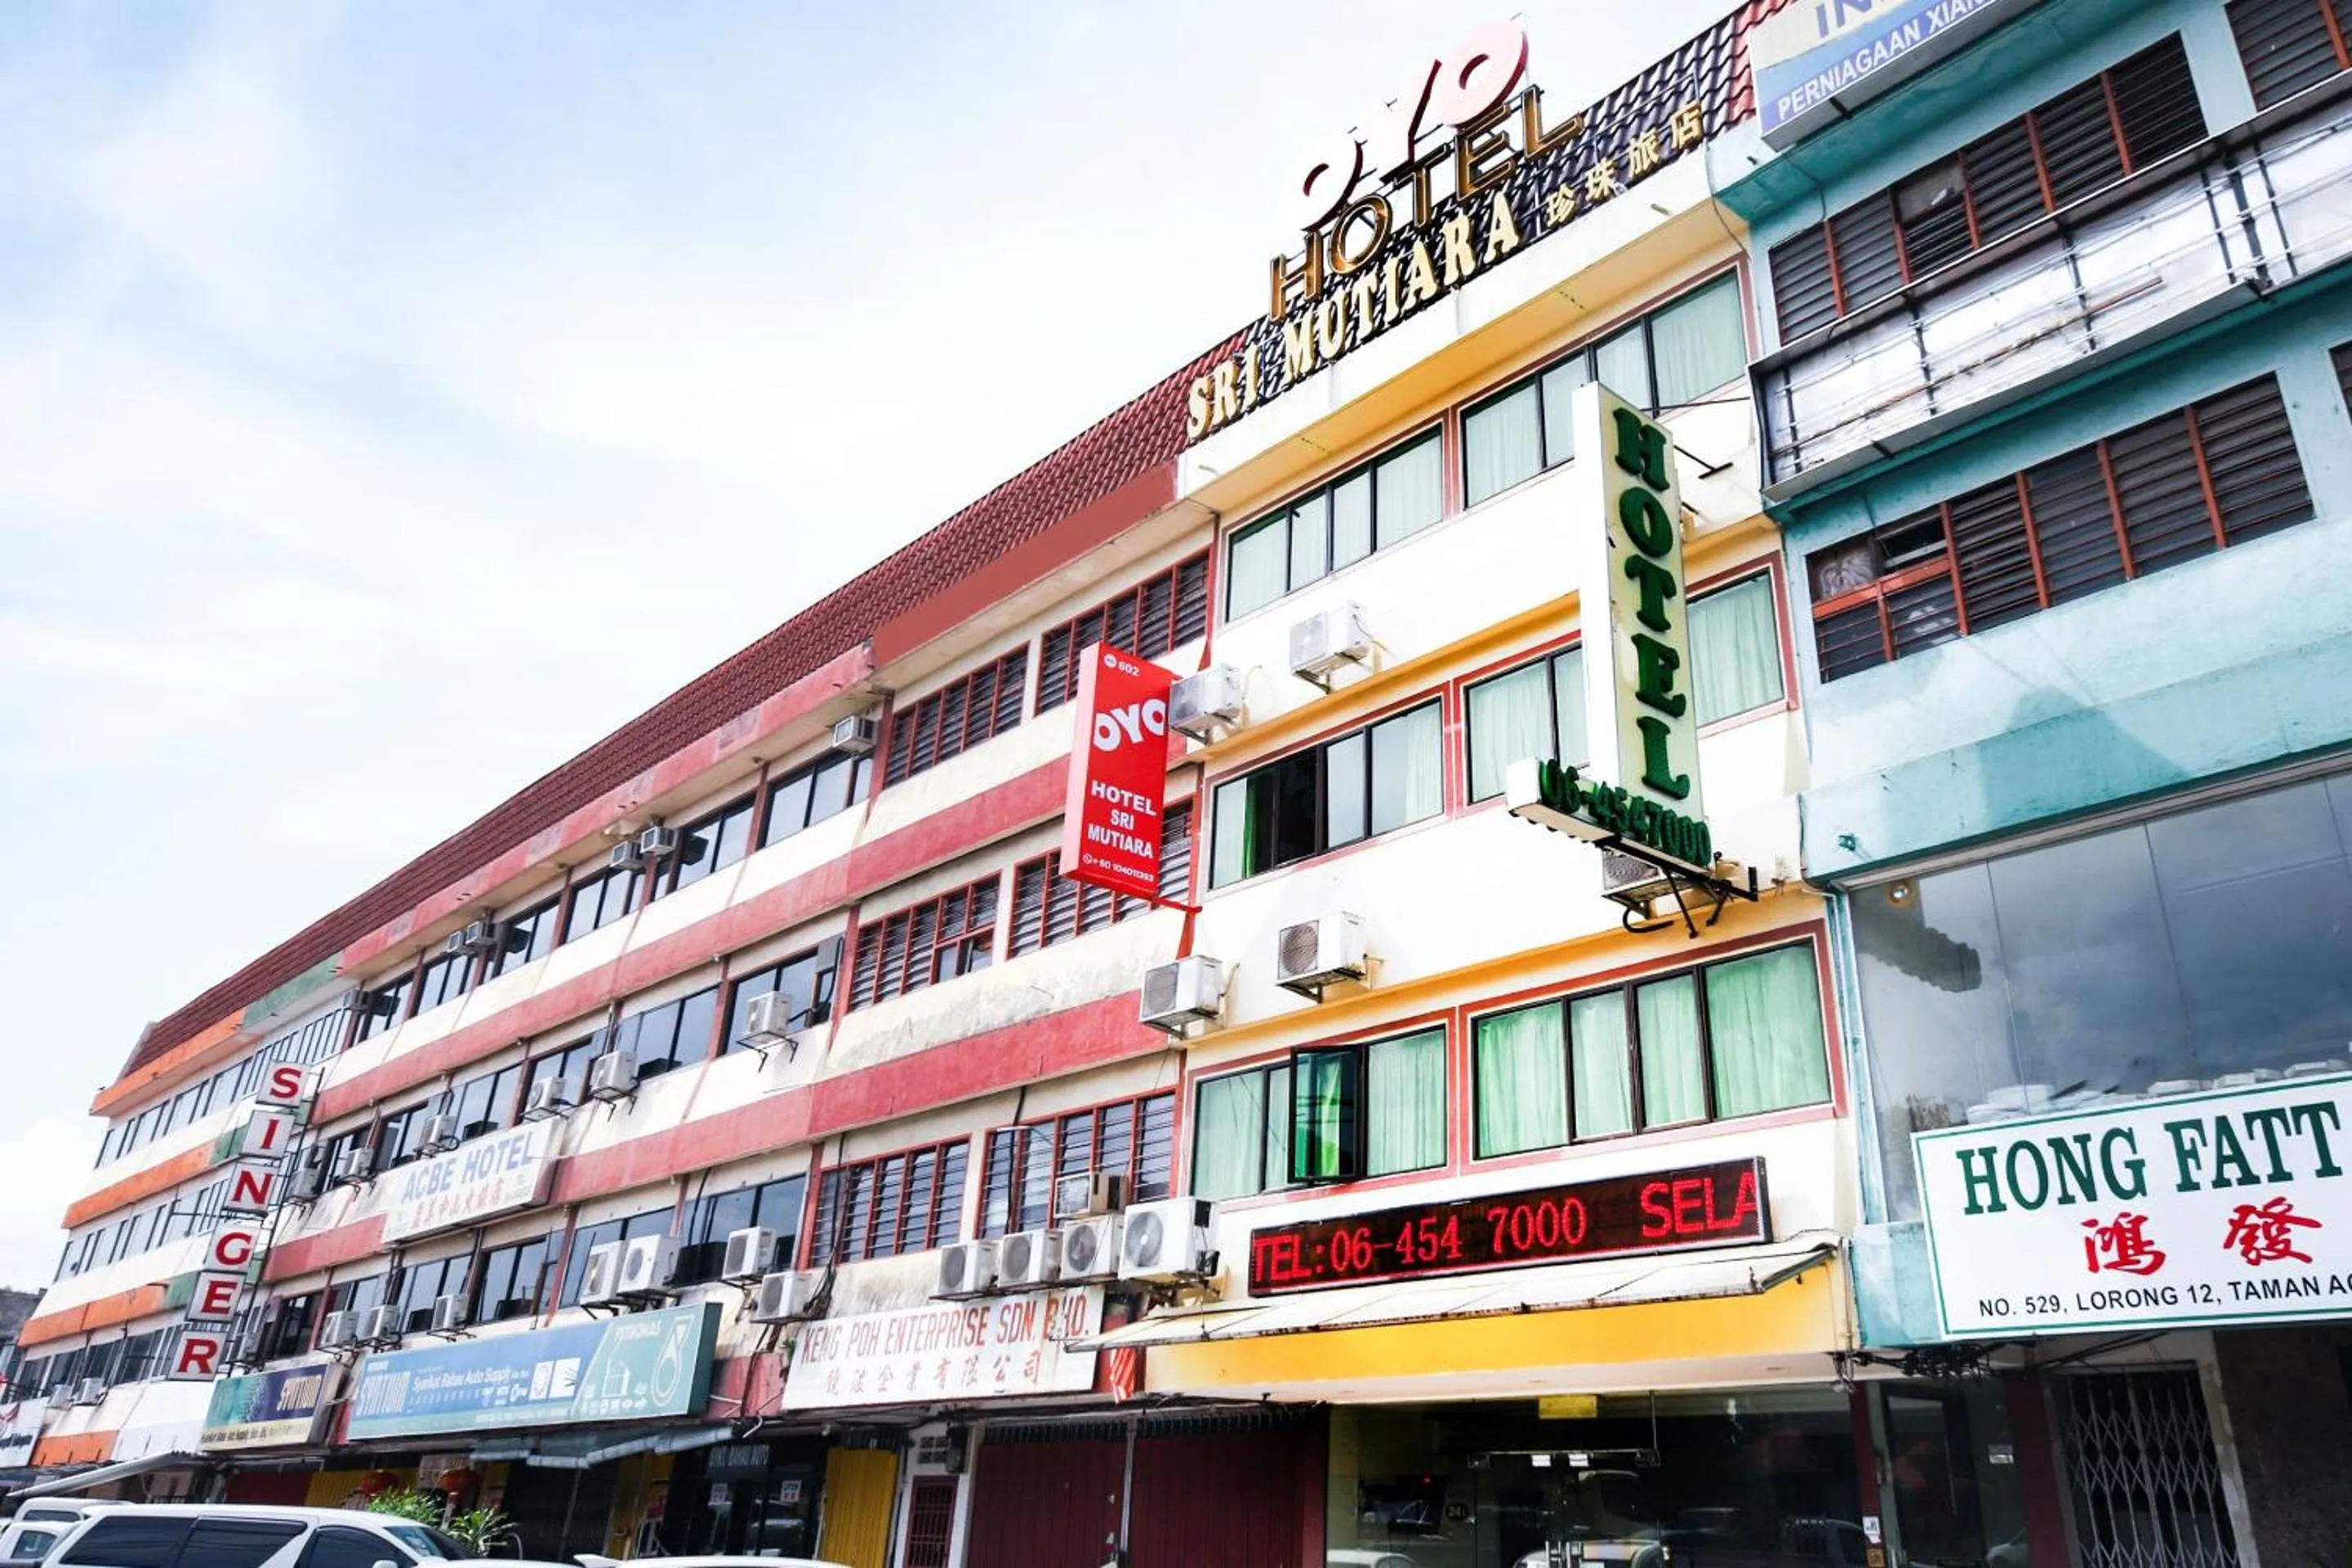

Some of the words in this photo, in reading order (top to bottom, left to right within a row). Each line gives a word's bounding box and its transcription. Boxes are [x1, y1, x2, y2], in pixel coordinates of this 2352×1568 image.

[1778, 18, 1920, 121] PERNIAGAAN
[1547, 100, 1704, 226] 珍珠旅店
[1269, 84, 1584, 324] HOTEL
[1187, 340, 1264, 439] SRI
[1281, 193, 1521, 380] MUTIARA
[1613, 407, 1690, 800] HOTEL
[1094, 698, 1167, 752] OYO
[1090, 780, 1157, 817] HOTEL
[1111, 808, 1134, 831] SRI
[1088, 823, 1154, 858] MUTIARA
[401, 1156, 457, 1204] ACBE
[462, 1132, 533, 1184] HOTEL
[1956, 1126, 2147, 1216] HONG
[2163, 1101, 2344, 1193] FATT
[175, 1067, 302, 1375] SINGER
[1488, 1196, 1587, 1255] 7000
[1642, 1170, 1757, 1238] SELA
[1980, 1298, 2017, 1317] NO.
[2025, 1294, 2068, 1316] 529,
[2076, 1286, 2179, 1312] LORONG
[2186, 1283, 2222, 1306] 12,
[2228, 1275, 2321, 1302] TAMAN
[801, 1325, 840, 1365] KENG
[845, 1320, 882, 1358] POH
[884, 1306, 991, 1356] ENTERPRISE
[485, 1366, 512, 1384] Supply
